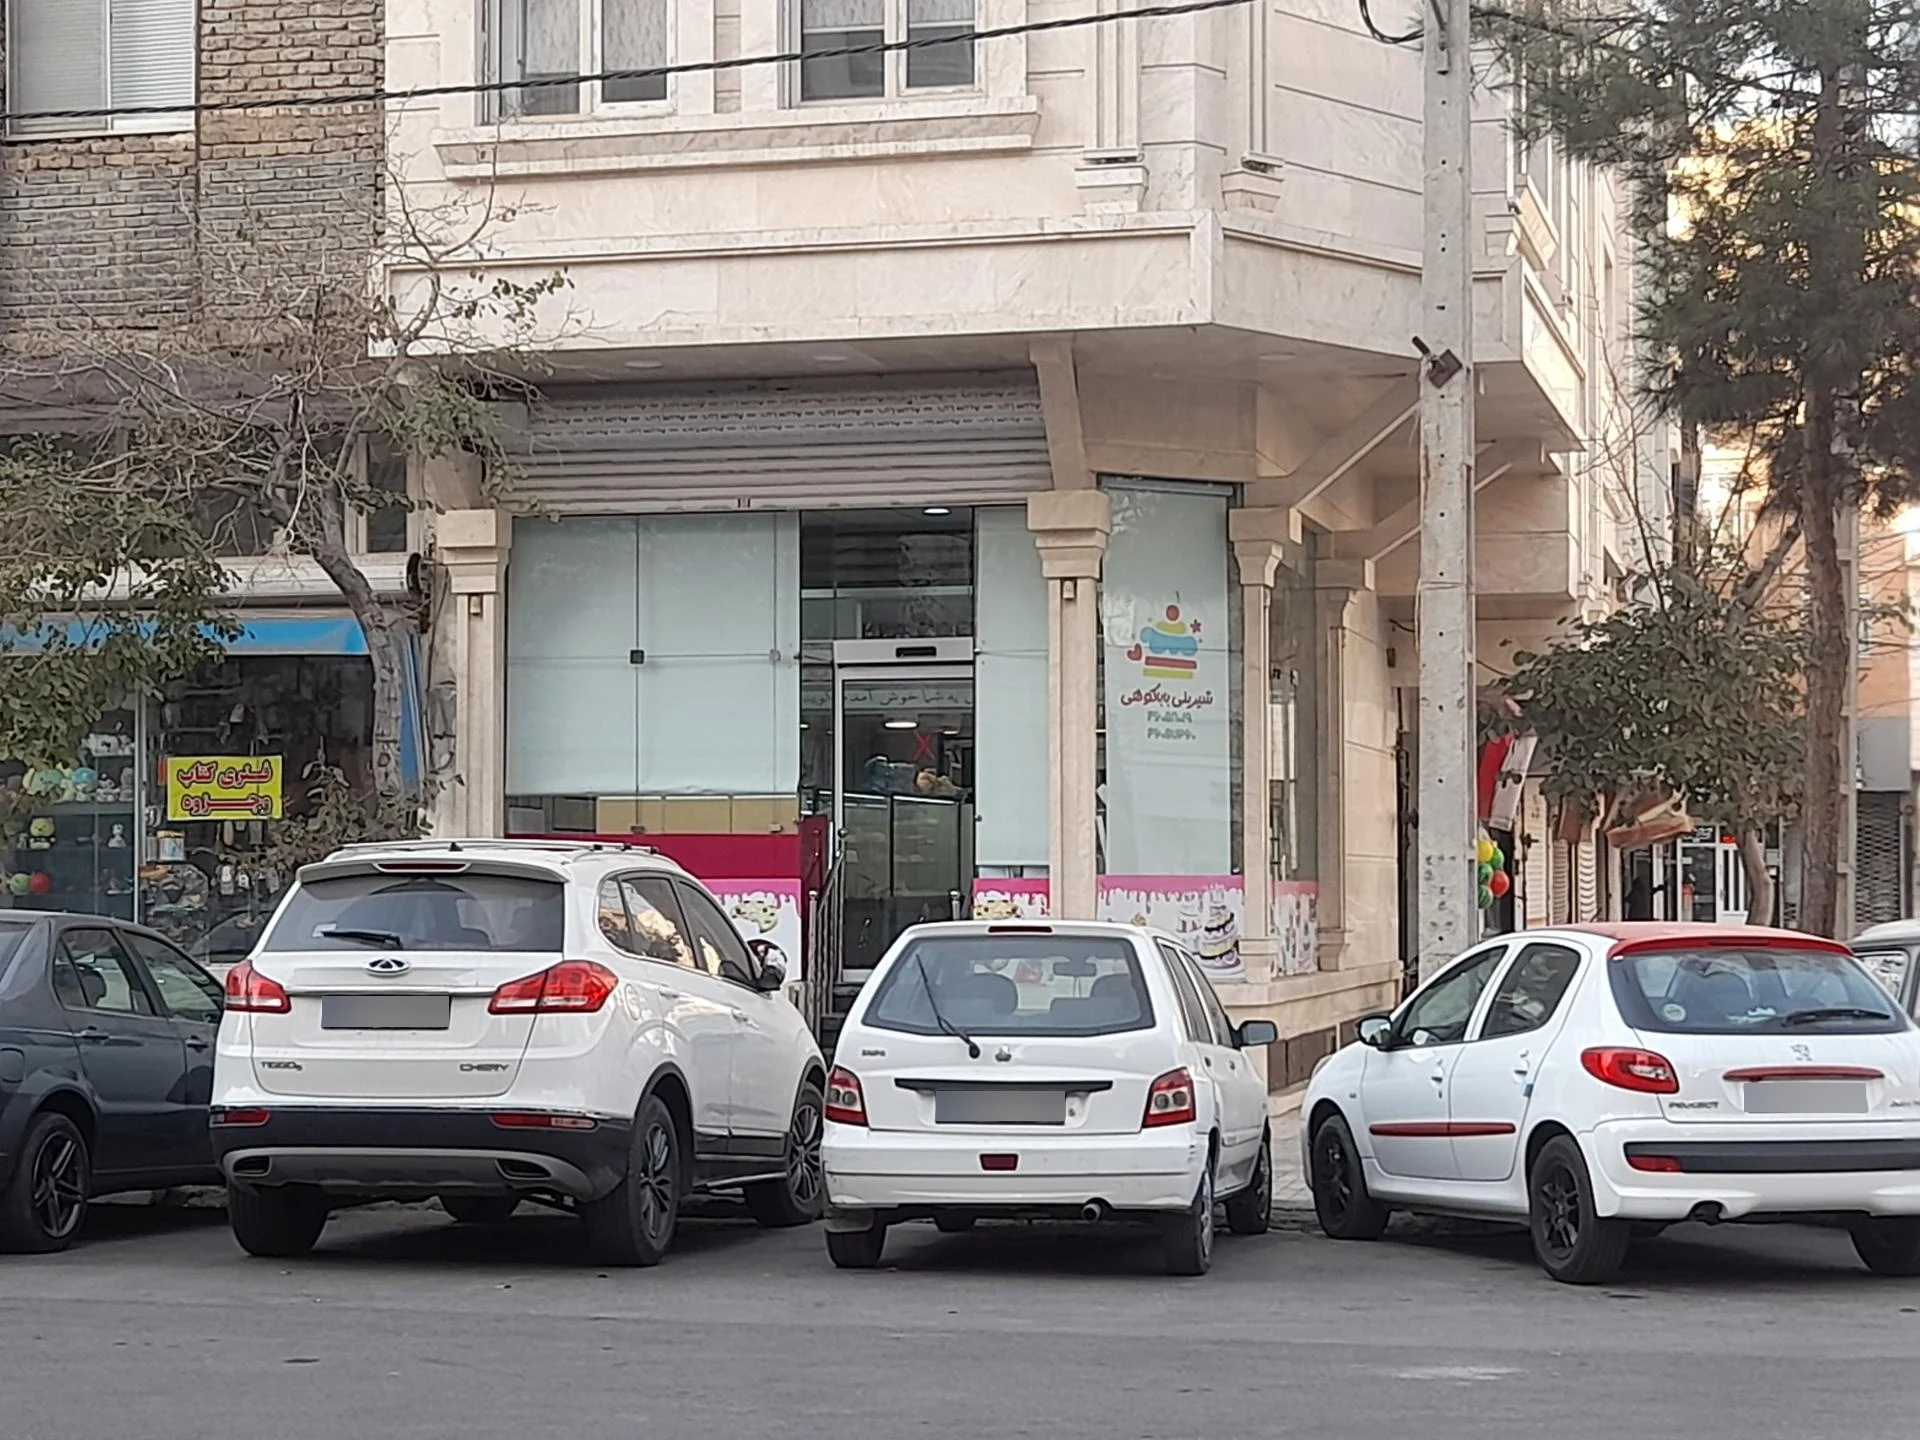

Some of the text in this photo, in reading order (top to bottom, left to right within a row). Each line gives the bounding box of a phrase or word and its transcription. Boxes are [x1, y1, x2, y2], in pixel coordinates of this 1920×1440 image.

[177, 759, 273, 789] فنری کتاب
[459, 1063, 509, 1072] CHERY
